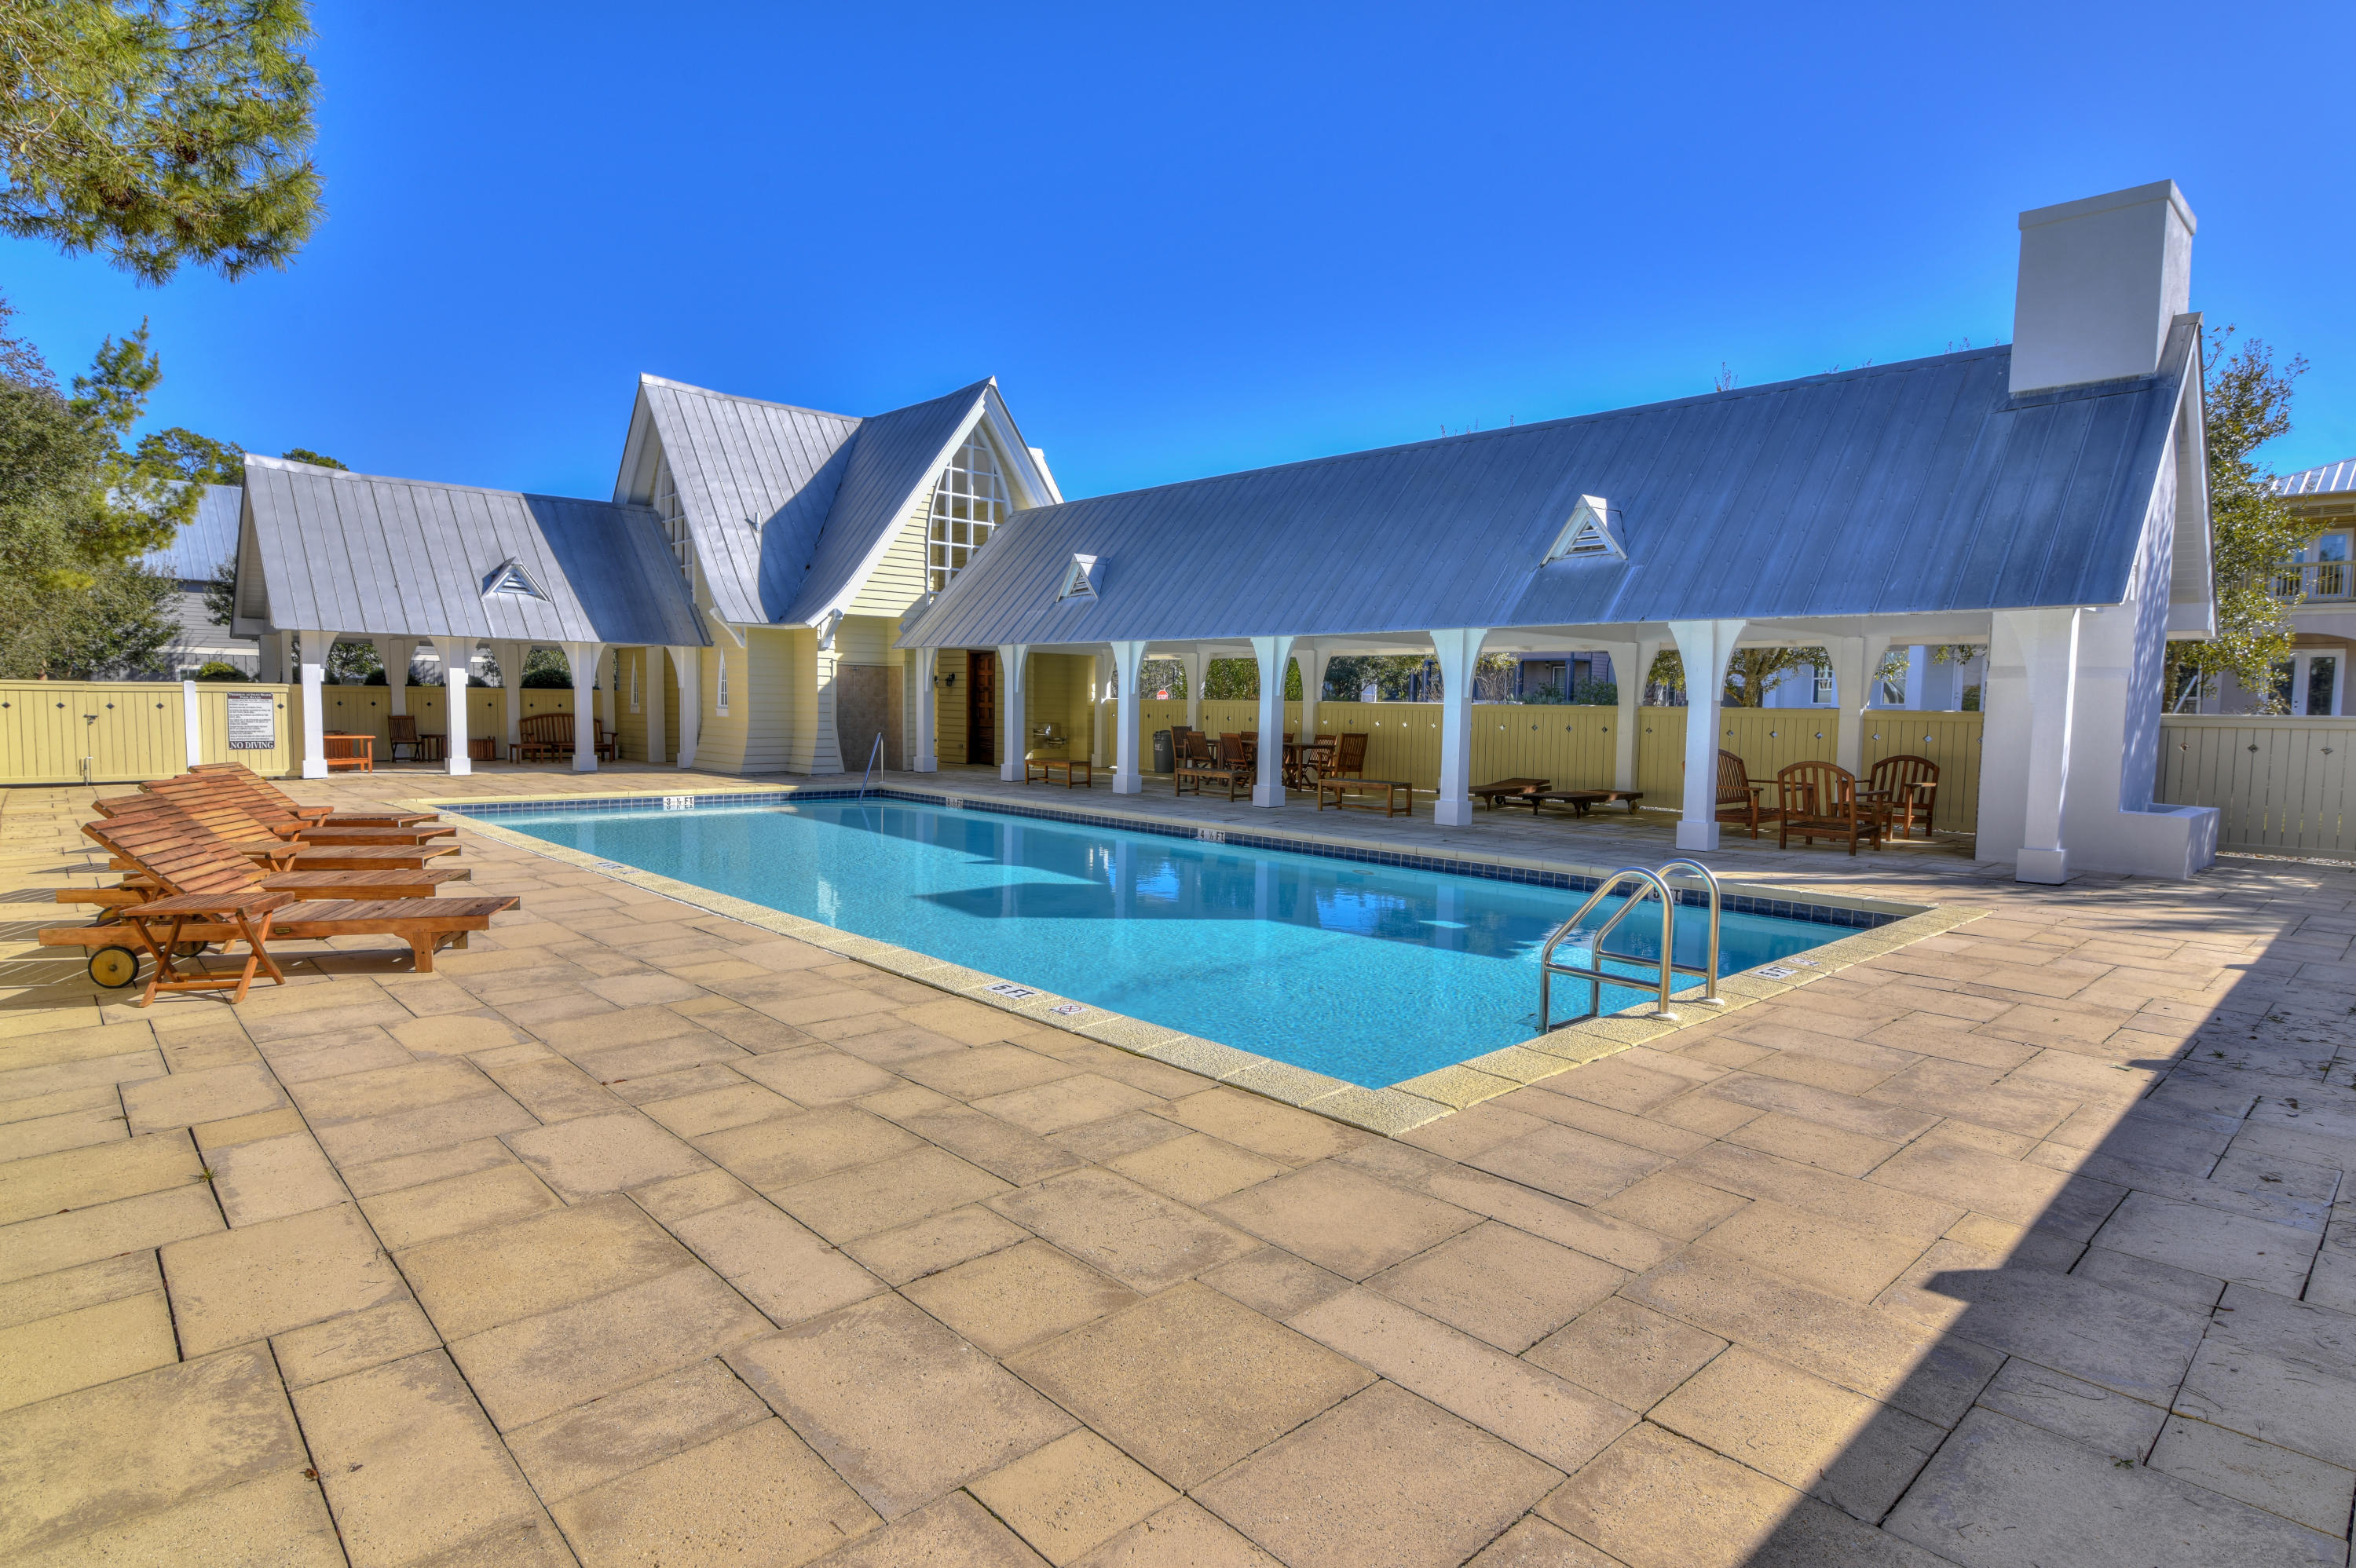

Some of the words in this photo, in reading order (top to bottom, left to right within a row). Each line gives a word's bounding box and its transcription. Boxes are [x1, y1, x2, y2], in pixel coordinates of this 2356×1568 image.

[1200, 830, 1205, 839] 4
[1216, 832, 1224, 841] FT
[1004, 989, 1035, 997] FT
